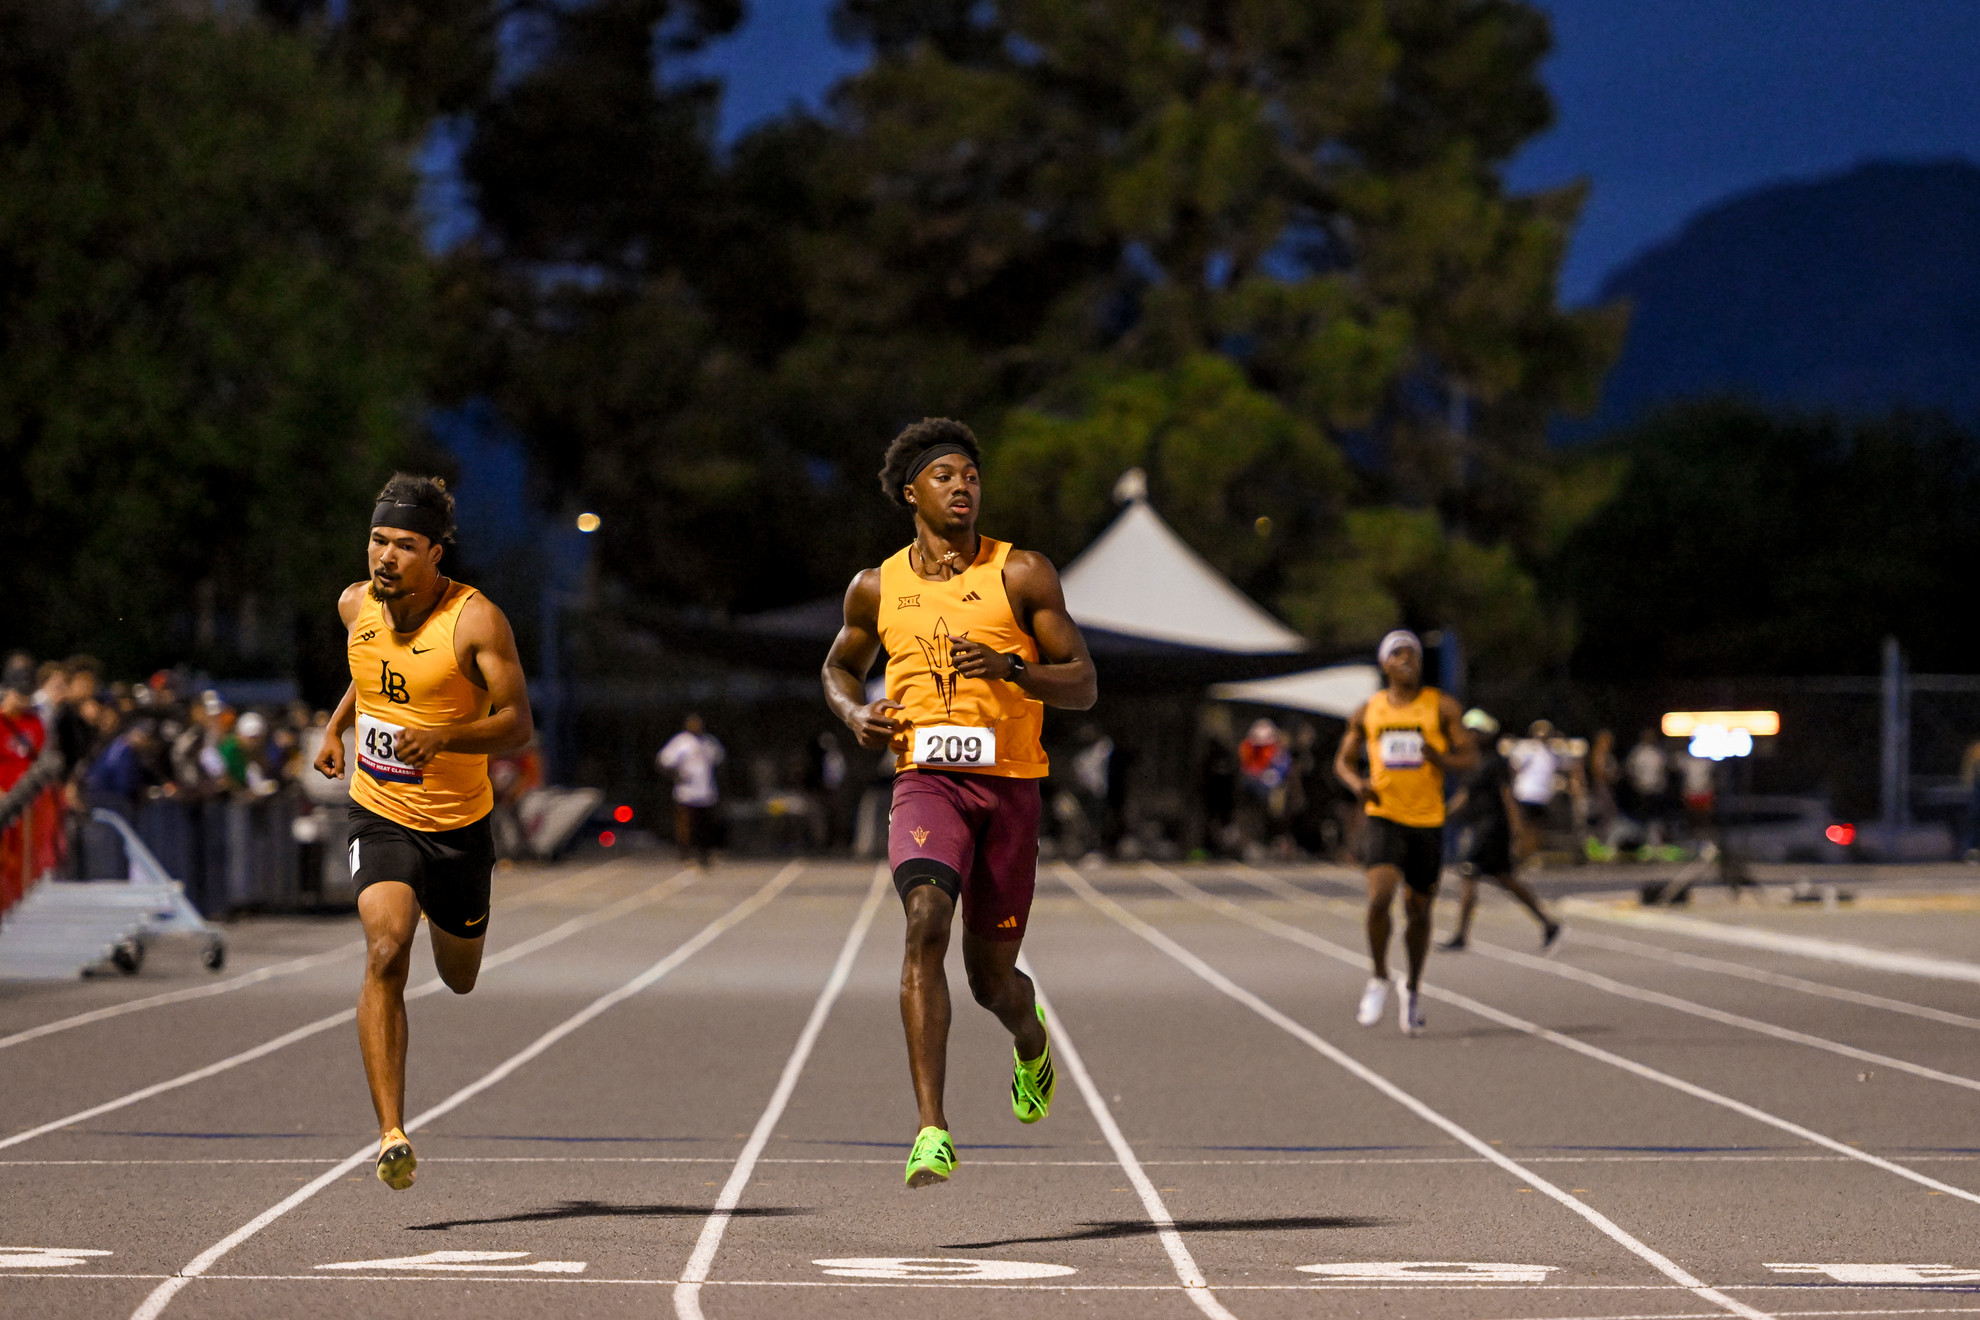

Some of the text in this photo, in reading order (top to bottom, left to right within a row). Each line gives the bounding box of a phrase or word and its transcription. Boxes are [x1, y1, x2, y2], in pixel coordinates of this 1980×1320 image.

[379, 659, 410, 704] LB
[365, 727, 403, 762] 43
[925, 735, 982, 763] 209
[376, 764, 391, 772] HEAT
[391, 767, 416, 776] CLASSIC
